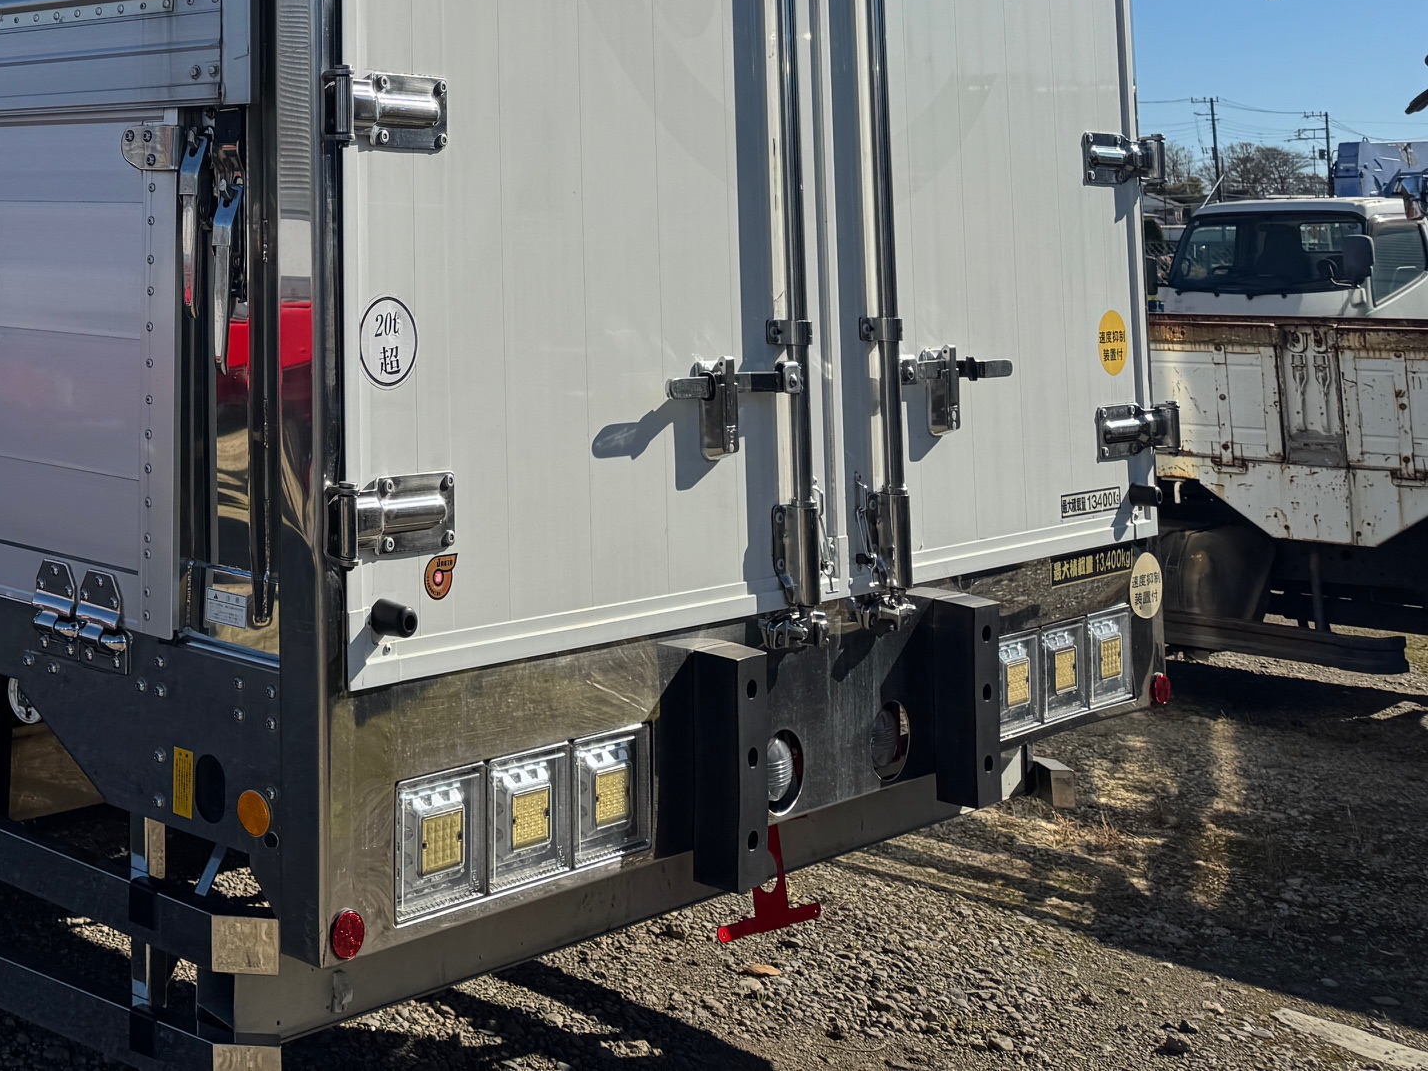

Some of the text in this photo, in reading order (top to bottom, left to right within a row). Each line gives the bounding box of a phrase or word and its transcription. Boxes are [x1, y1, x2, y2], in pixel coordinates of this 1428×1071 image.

[374, 311, 400, 337] 20t
[1098, 330, 1126, 344] 速度抑制
[379, 345, 401, 375] 超
[1102, 347, 1123, 362] 装置付
[1131, 571, 1160, 588] 速度抑制
[1134, 589, 1157, 605] 装置付
